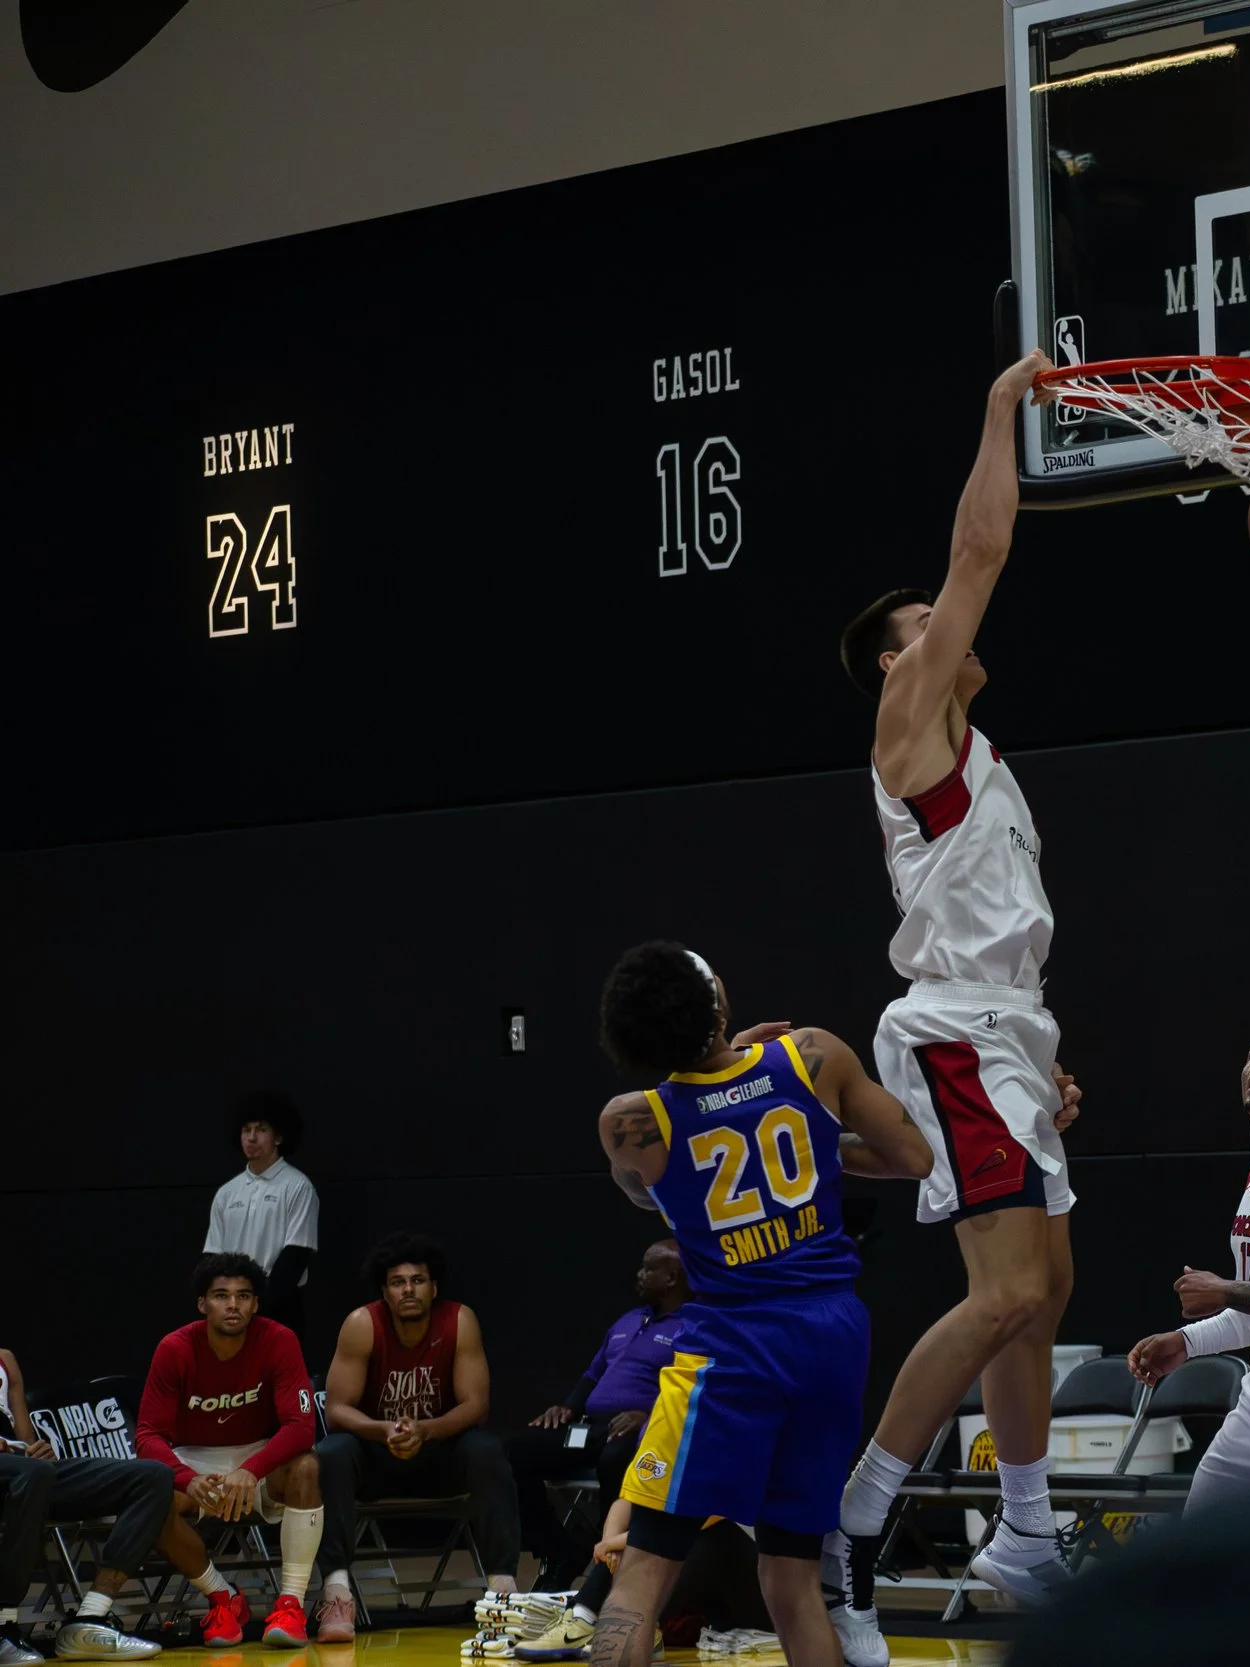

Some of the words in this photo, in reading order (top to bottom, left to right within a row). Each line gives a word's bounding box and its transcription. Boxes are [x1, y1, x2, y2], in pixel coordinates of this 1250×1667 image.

[653, 347, 740, 403] GASOL
[203, 423, 294, 477] BRYANT
[1043, 449, 1095, 474] SPALDING
[656, 436, 741, 577] 16
[206, 504, 297, 638] 24
[687, 1103, 819, 1231] 20
[719, 1216, 791, 1267] SMITH
[794, 1204, 825, 1241] JR.
[188, 1381, 263, 1413] FORCE
[384, 1366, 436, 1402] SIOUX
[57, 1402, 101, 1440] NBA
